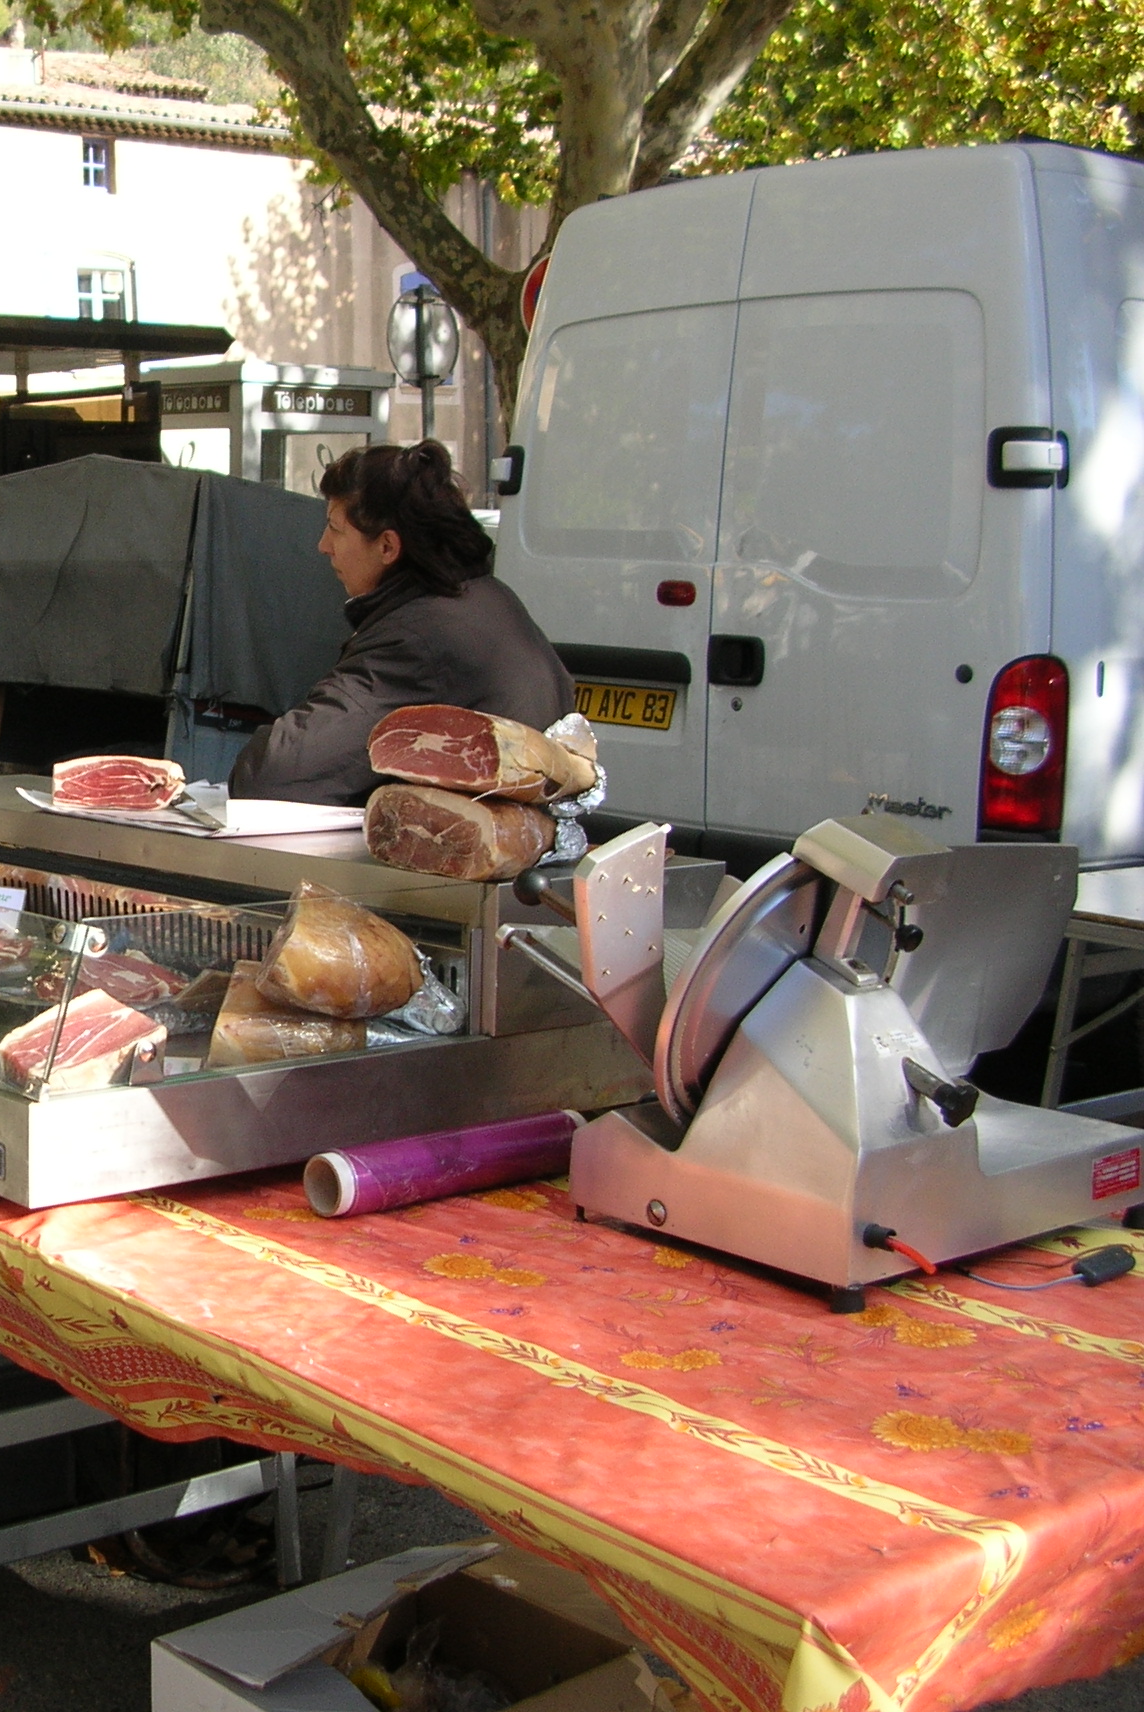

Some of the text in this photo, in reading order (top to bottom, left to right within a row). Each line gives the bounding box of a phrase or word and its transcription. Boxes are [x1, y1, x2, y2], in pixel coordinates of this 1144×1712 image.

[274, 391, 354, 413] Téléphone
[597, 688, 636, 720] AYC
[642, 692, 670, 724] 83
